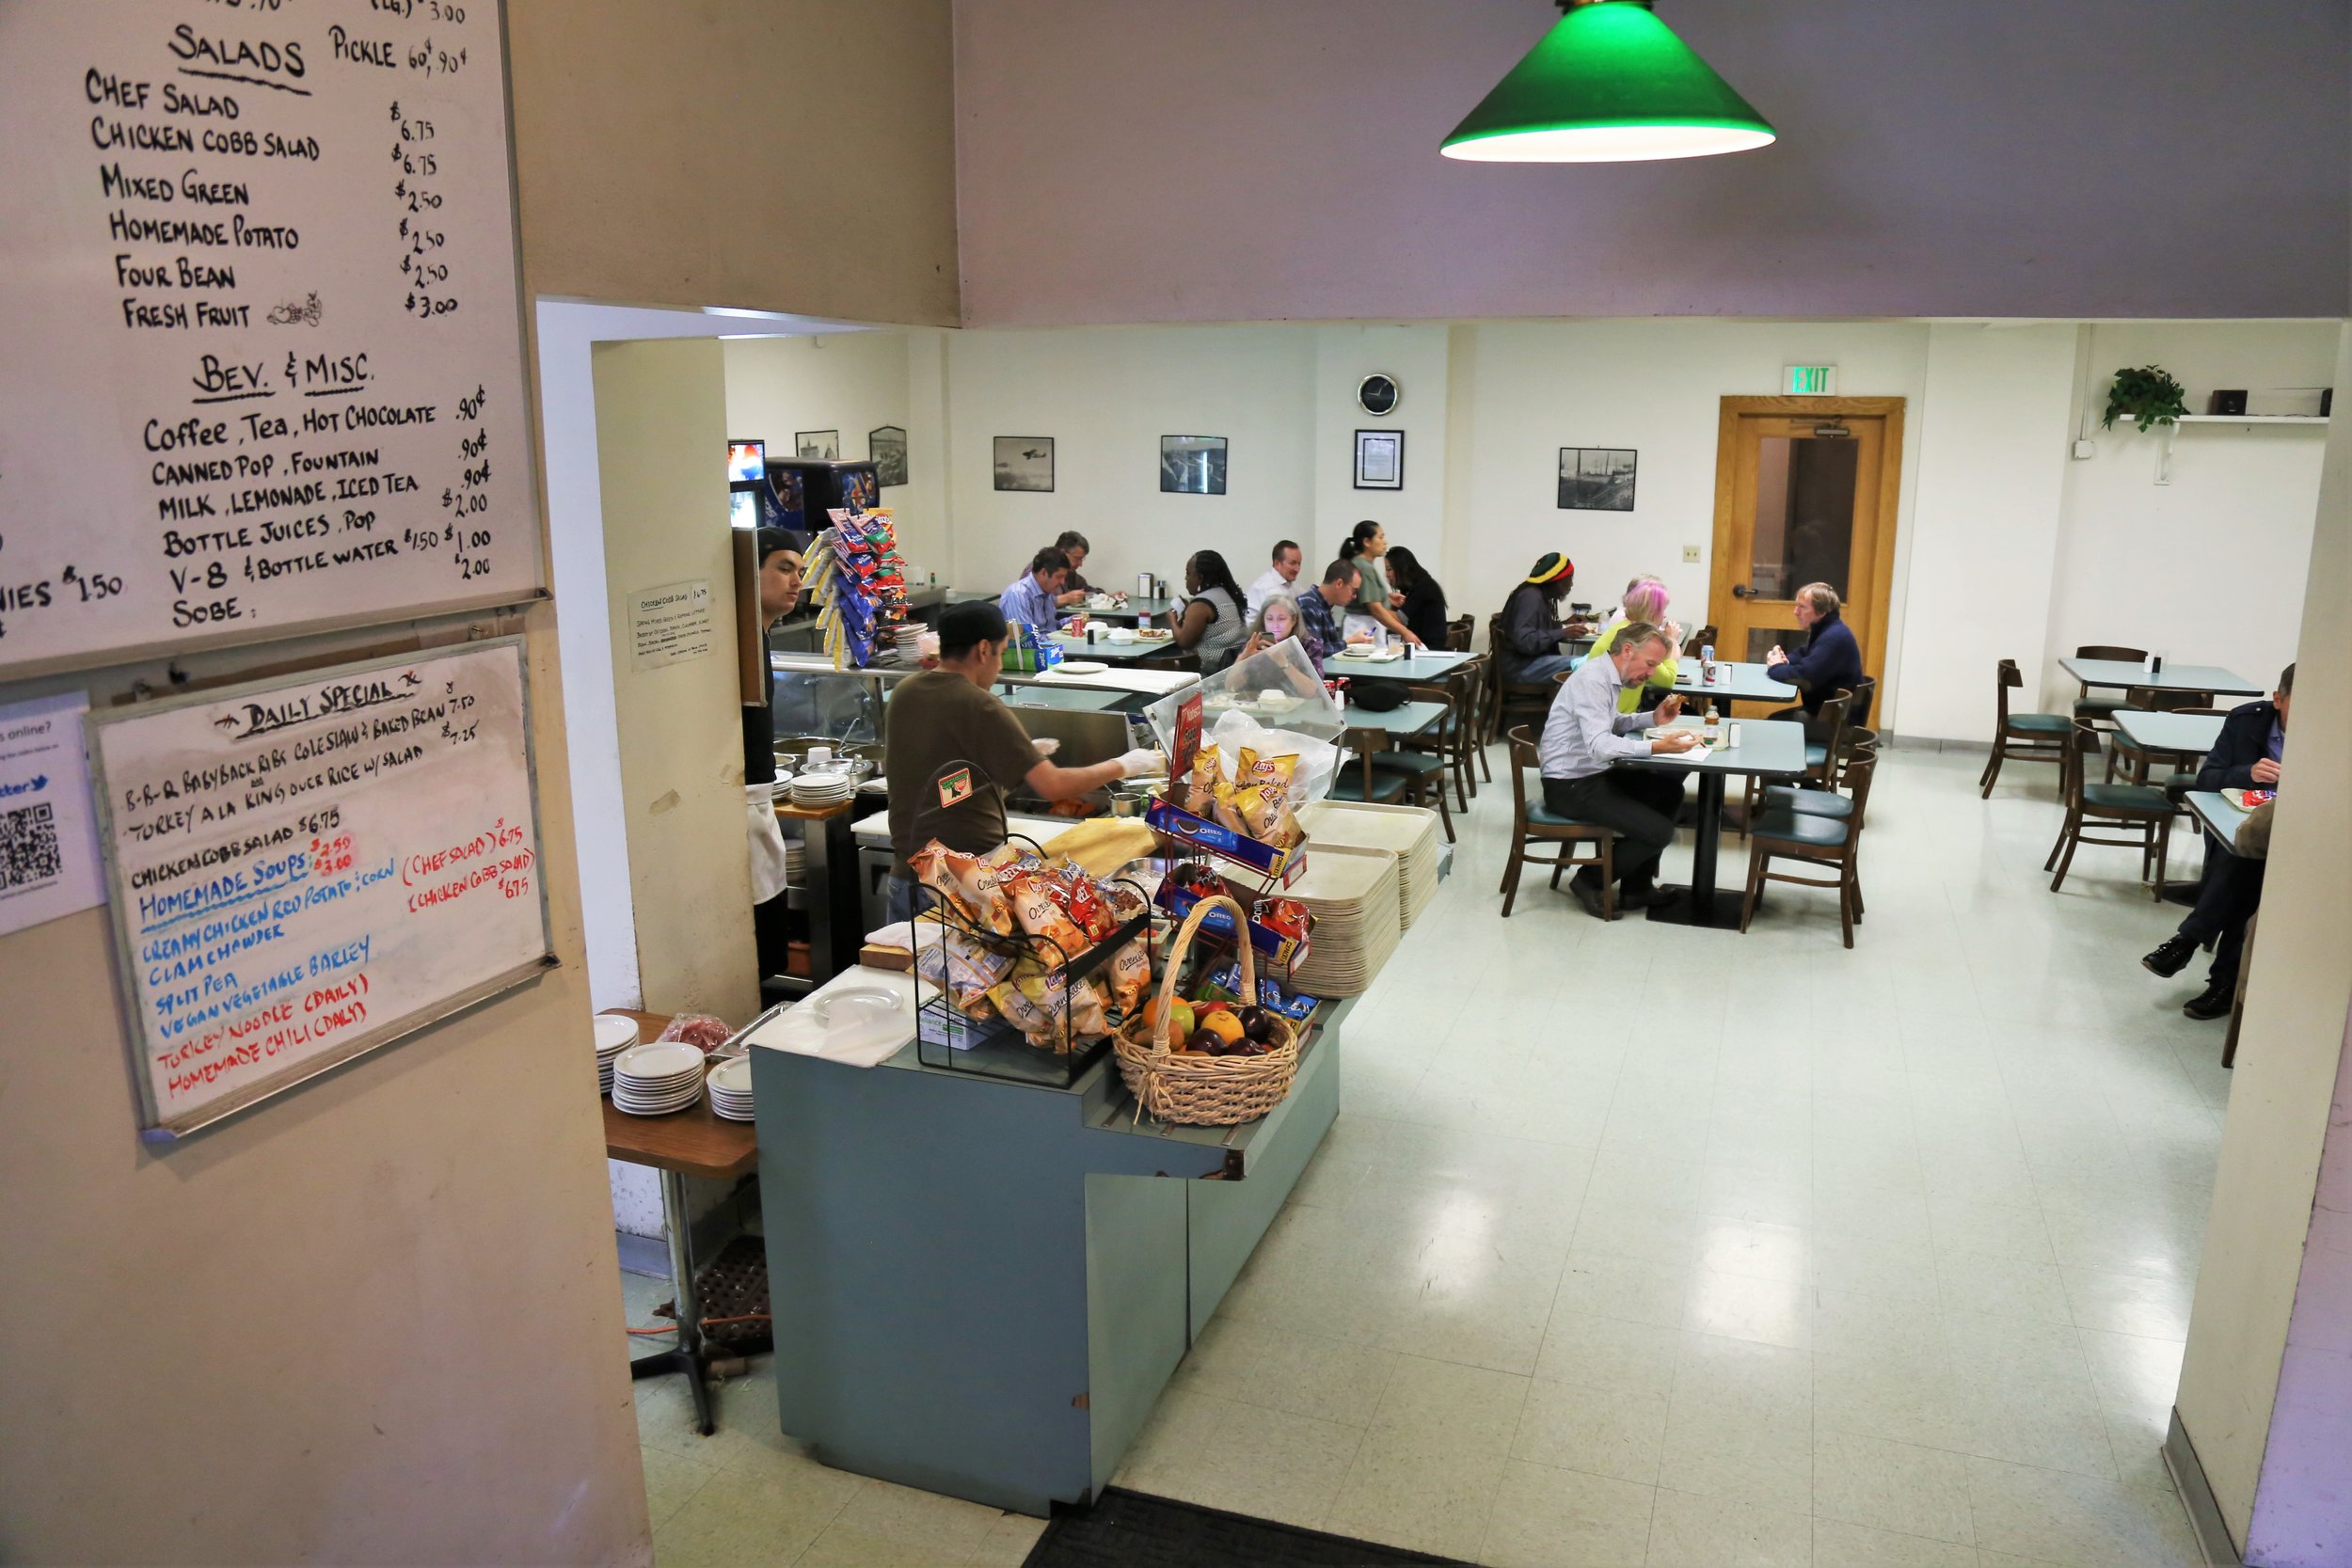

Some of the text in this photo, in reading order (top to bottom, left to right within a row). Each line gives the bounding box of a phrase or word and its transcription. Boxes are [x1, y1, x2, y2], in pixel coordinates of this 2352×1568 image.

[167, 24, 306, 77] SALADS
[329, 25, 396, 68] PICKLE
[85, 69, 151, 110] CHEF
[163, 83, 239, 120] SALAD
[91, 117, 437, 176] CHICKEN COBB SALAD $6.75
[100, 164, 442, 213] MIXED GREEN $2.50
[109, 212, 229, 247] HOMEMADE
[232, 214, 299, 249] POTATO
[116, 255, 172, 288] FOUR
[176, 258, 235, 289] BEAN
[123, 292, 458, 329] FRESH FRUIT $3.00
[193, 354, 269, 393] BEV.
[305, 354, 374, 385] MISC.
[1792, 367, 1829, 392] EXIT
[303, 411, 340, 433] HOT
[344, 404, 437, 428] CHOCOLATE
[151, 461, 233, 487] CANNED
[291, 448, 380, 474] FOUNTAIN
[337, 476, 380, 500] ICED
[382, 473, 419, 494] TEA
[163, 530, 253, 558] BOTTLE
[343, 510, 376, 532] POP
[442, 487, 487, 517] $2.00
[169, 562, 228, 594] V-8
[258, 551, 328, 580] BOTTLE
[332, 538, 398, 565] WATER
[444, 522, 491, 553] $1.00
[454, 553, 490, 580] $2.00
[242, 681, 392, 729] DAILY SPECIAL
[8, 721, 52, 740] online?
[258, 749, 287, 773] RIBS
[373, 715, 409, 740] BAKED
[411, 704, 445, 729] BEAN
[246, 784, 285, 811] KING
[290, 774, 324, 797] OVER
[328, 763, 359, 787] RICE
[382, 745, 423, 768] SALAD
[132, 806, 341, 890] CHICKEN COBB SALAD $6.75
[1199, 827, 1223, 837] OREO
[139, 871, 248, 924] HOMEMADE
[469, 864, 499, 890] COBB
[143, 927, 200, 964] CREAMY
[203, 900, 269, 942] CHICKEN
[273, 895, 301, 921] RED
[362, 858, 395, 887] CORN
[1208, 911, 1232, 922] OREO
[150, 923, 285, 987] CLAM CHOWDER
[156, 971, 238, 1016] SPLIT PEA
[161, 934, 370, 1039] VEGAN VEGETABLE BARLEY
[157, 973, 369, 1069] TURKEY NOODLE (DAILY)
[168, 1001, 367, 1099] HOMEMADE CHILI (DAILY)
